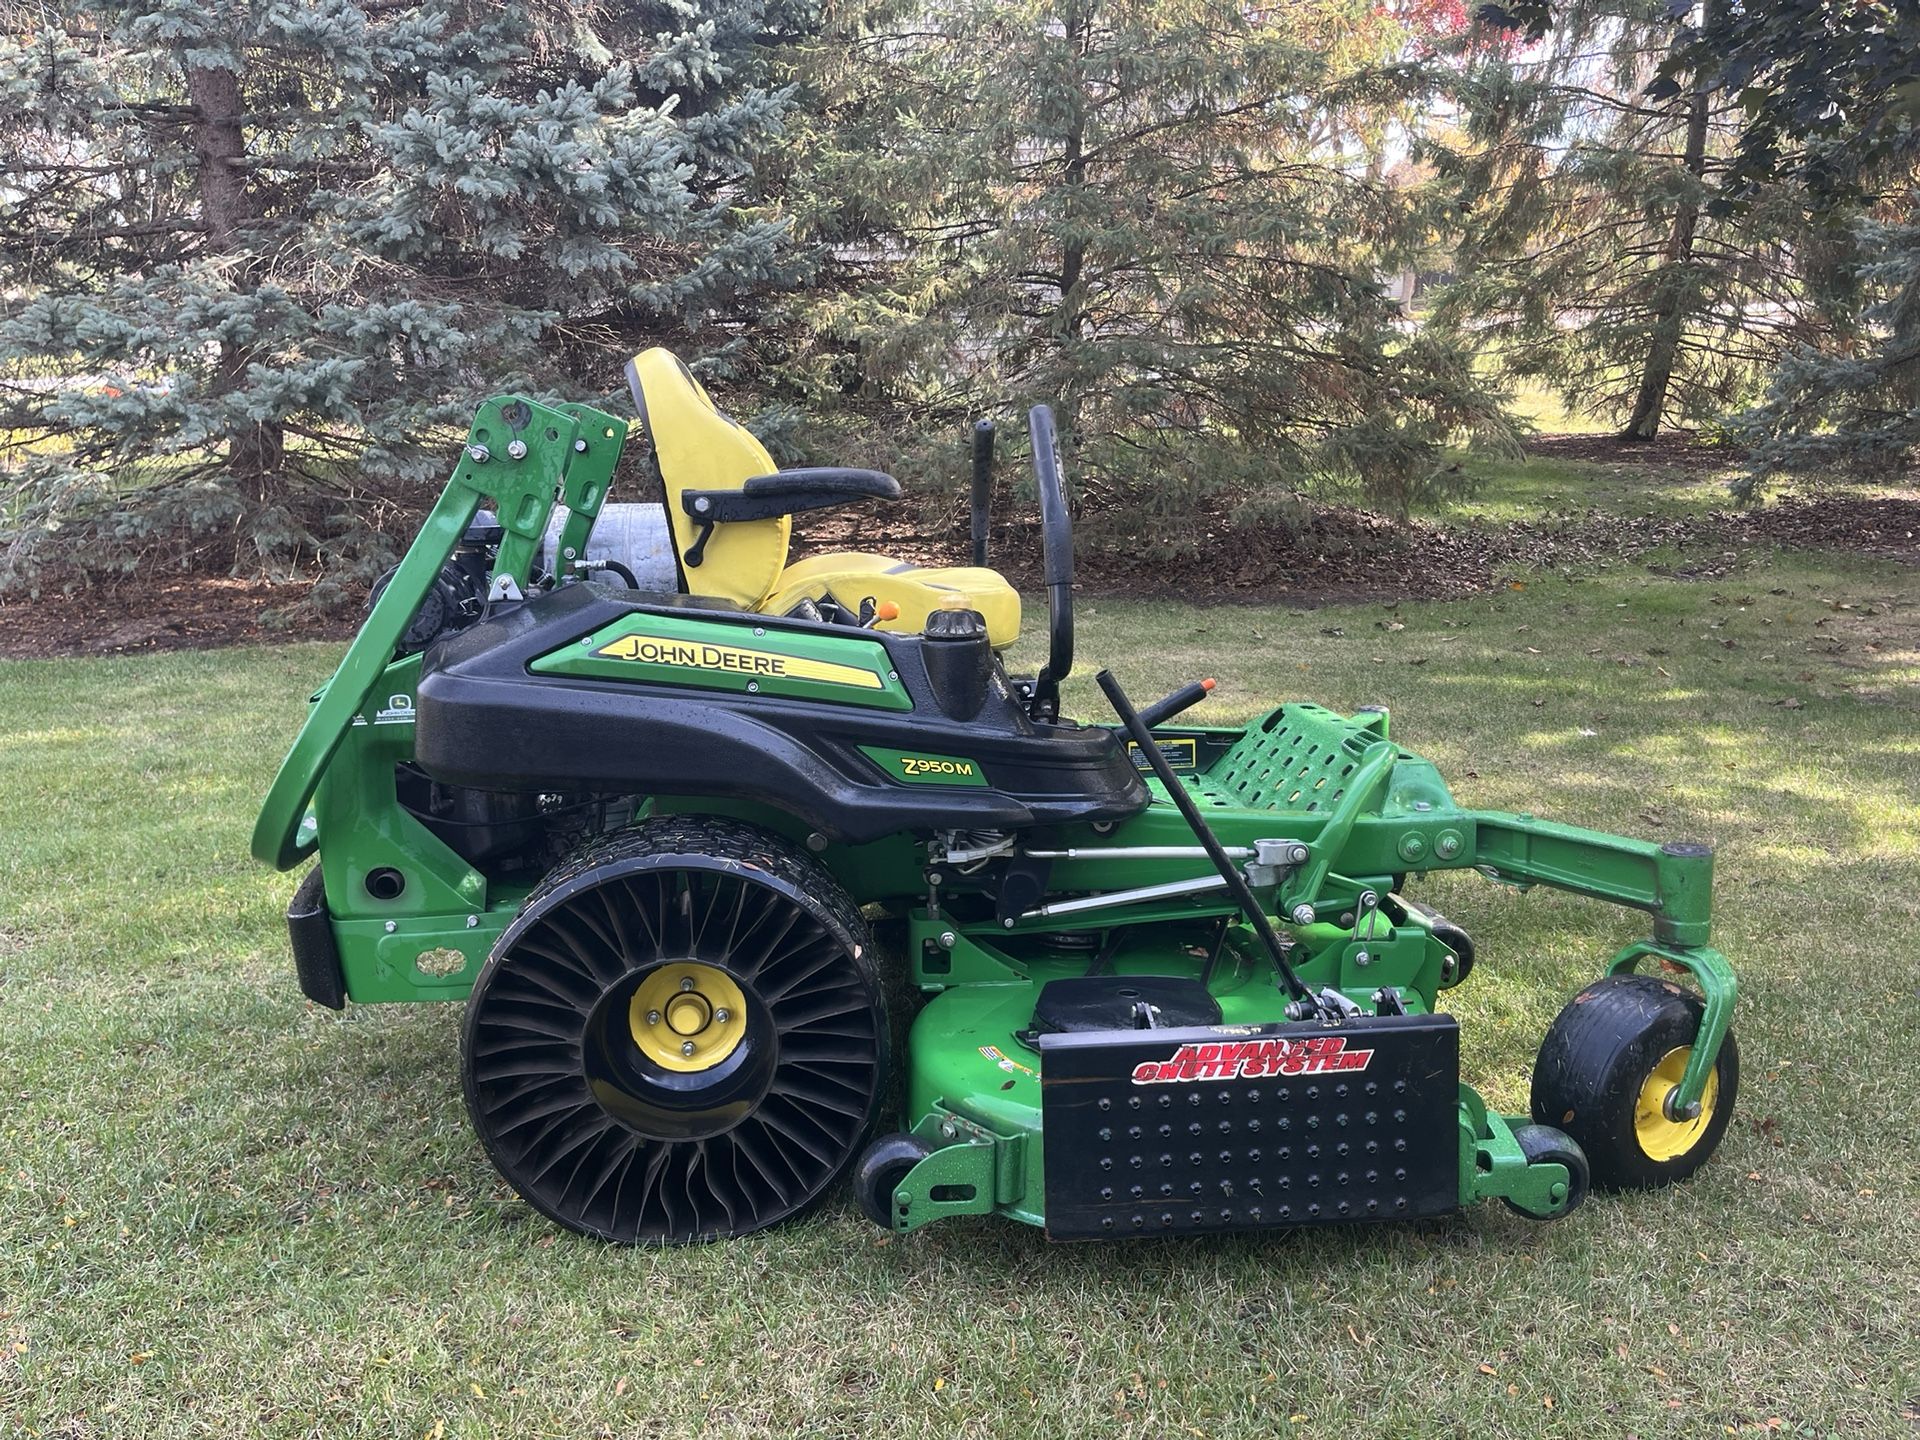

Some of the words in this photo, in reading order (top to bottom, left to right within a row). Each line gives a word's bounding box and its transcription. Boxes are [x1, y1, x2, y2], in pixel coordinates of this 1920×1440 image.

[625, 639, 696, 664] JOHN
[702, 646, 786, 675] DEERE
[901, 758, 973, 776] Z950M
[1133, 1060, 1238, 1083] CHUTE
[1242, 1051, 1373, 1078] SYSTEM
